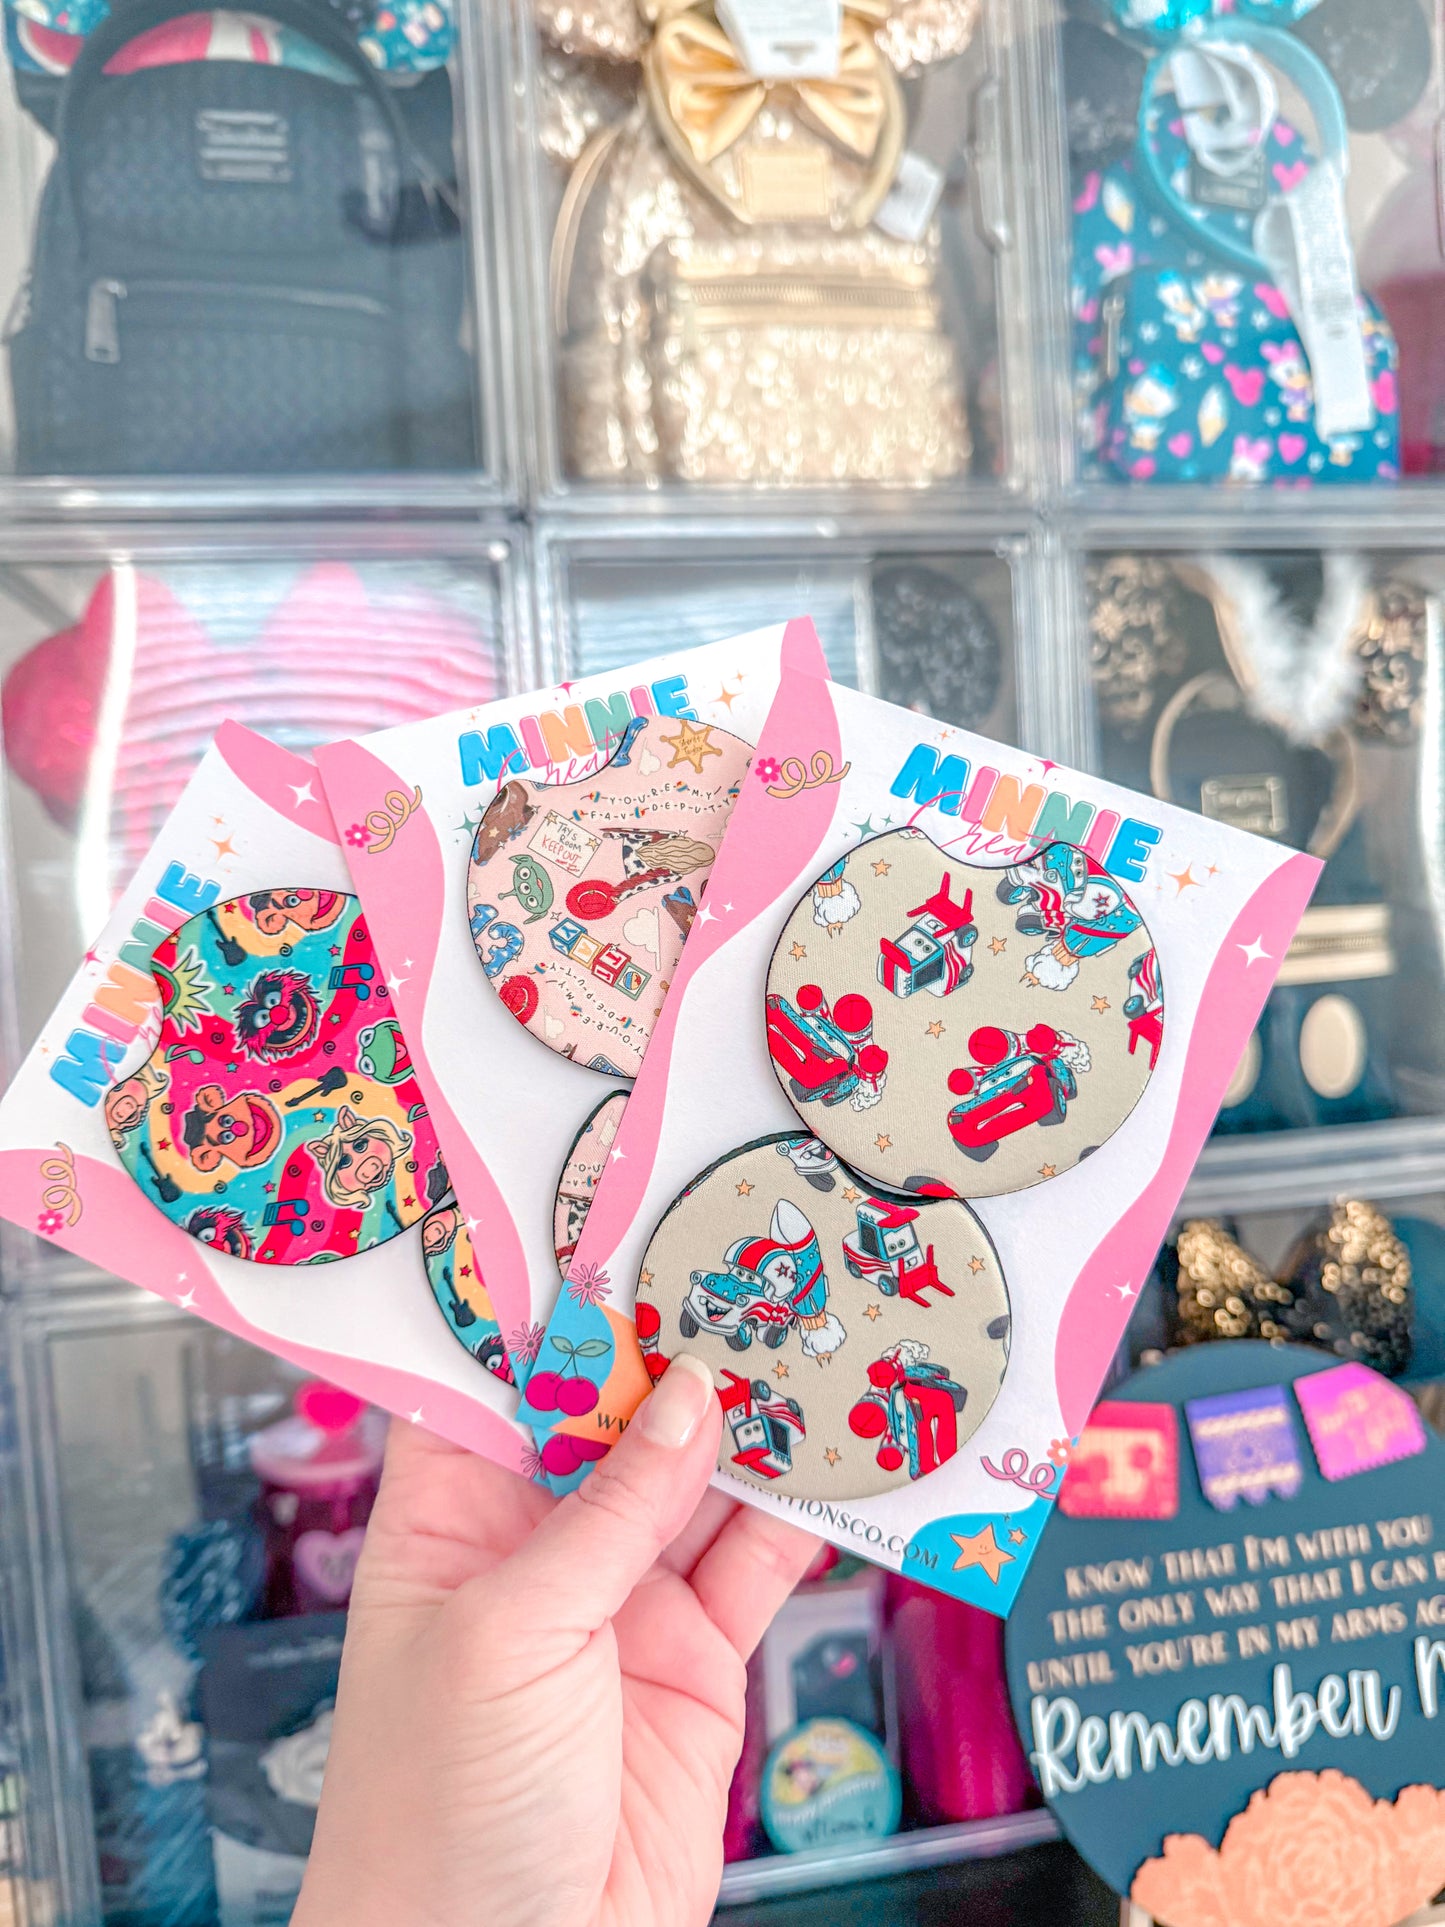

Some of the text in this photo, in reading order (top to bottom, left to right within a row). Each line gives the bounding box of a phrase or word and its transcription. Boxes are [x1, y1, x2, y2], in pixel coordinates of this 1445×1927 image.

[458, 674, 699, 787] MINNIE
[541, 834, 583, 864] KEEP OUT
[889, 743, 1163, 883] MINNIE
[50, 860, 222, 1108] MINNIE
[1048, 1603, 1110, 1645] THE
[1118, 1592, 1196, 1634] ONLY
[1204, 1583, 1261, 1617] WAY
[1270, 1567, 1342, 1608] THAT
[1350, 1559, 1366, 1596] I
[1371, 1554, 1428, 1592] CAN
[1065, 1556, 1153, 1599] KNOW
[1161, 1542, 1238, 1585] THAT
[1296, 1523, 1372, 1563] WITH
[1377, 1514, 1433, 1548] YOU
[1027, 1650, 1116, 1693] UNTIL
[1125, 1629, 1229, 1678] YOU'RE
[1237, 1626, 1271, 1659] IN
[1276, 1615, 1320, 1651] MY
[1331, 1602, 1408, 1644] ARMS
[1030, 1663, 1402, 1798] Remember
